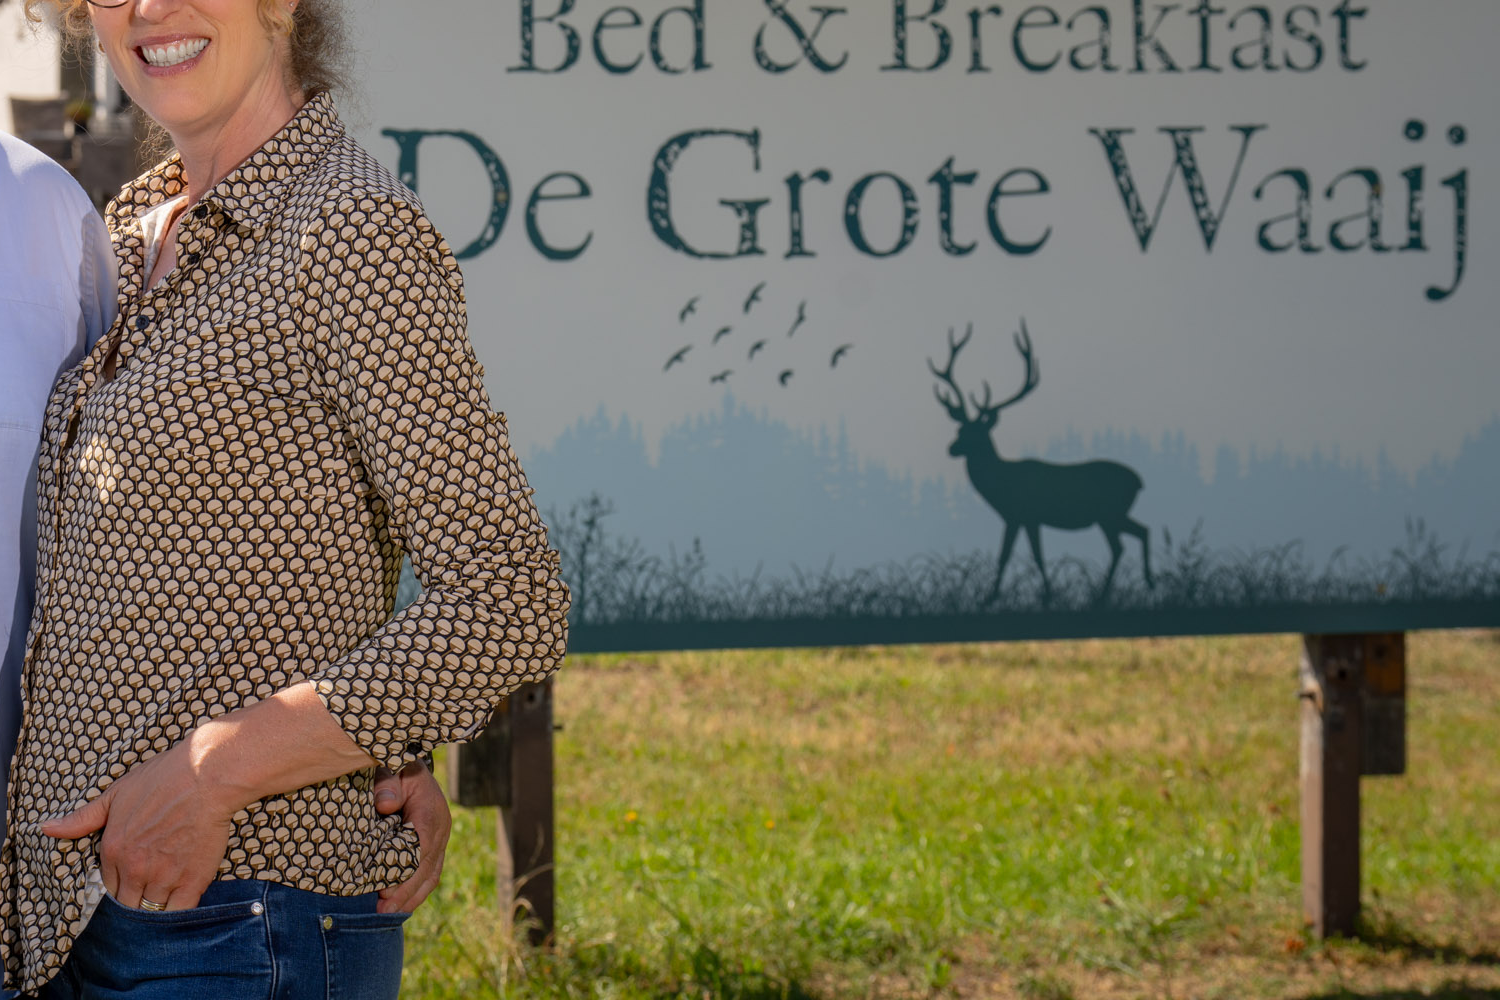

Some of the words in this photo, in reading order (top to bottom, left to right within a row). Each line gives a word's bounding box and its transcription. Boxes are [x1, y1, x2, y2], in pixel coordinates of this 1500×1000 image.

[381, 127, 594, 262] De
[646, 126, 1053, 261] Grote
[1087, 119, 1469, 302] Waaij
